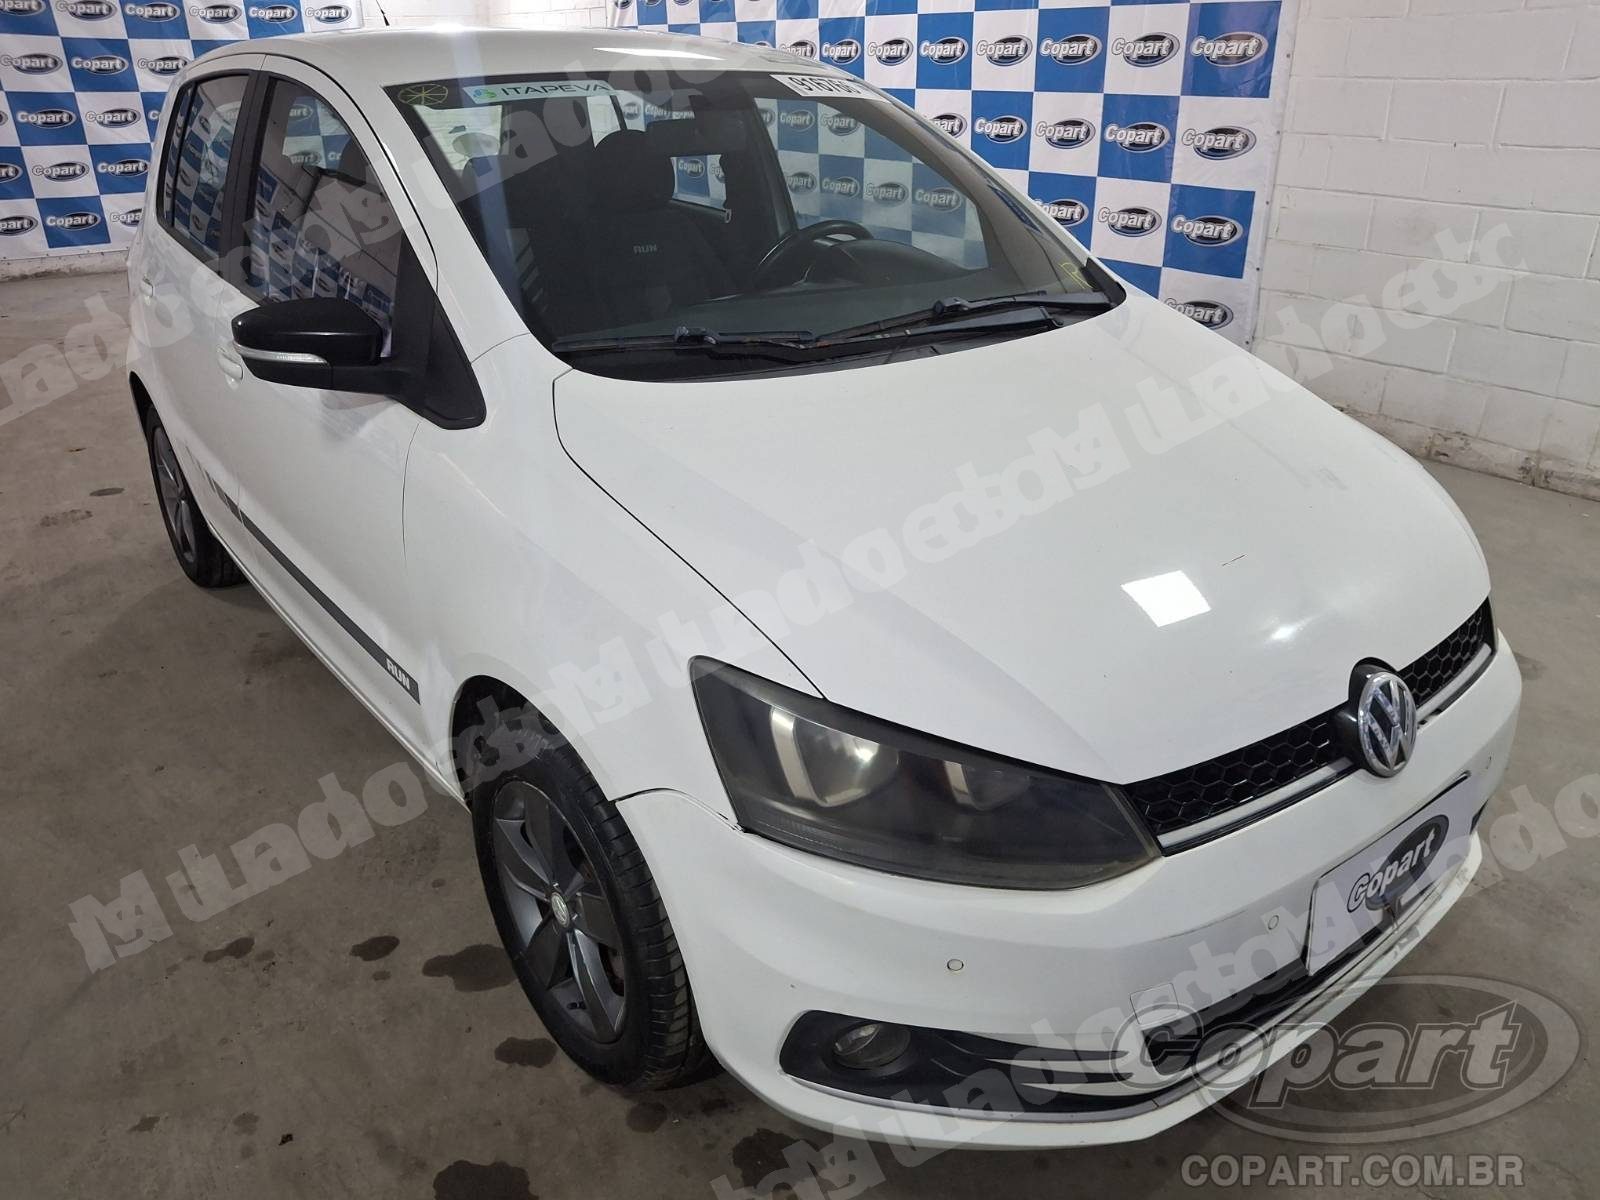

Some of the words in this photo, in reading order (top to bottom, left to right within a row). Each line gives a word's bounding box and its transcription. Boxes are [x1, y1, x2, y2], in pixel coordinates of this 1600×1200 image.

[0, 0, 38, 11] opart
[57, 0, 111, 16] Copart
[125, 4, 175, 17] Copart
[190, 6, 235, 19] Copart
[249, 7, 292, 18] Copart
[306, 7, 346, 19] Copart
[822, 42, 858, 58] Copart
[868, 41, 907, 58] Copart
[920, 40, 963, 58] Copart
[976, 40, 1026, 59] Copart
[1041, 38, 1096, 58] Copart
[1112, 38, 1171, 59] Copart
[1190, 36, 1259, 59] Copart
[1, 55, 54, 70] Copart
[72, 57, 122, 70] Copart
[138, 58, 187, 72] Copart
[501, 84, 611, 96] ITAPEVA
[17, 111, 71, 125] Copart
[86, 111, 134, 125] Copart
[780, 111, 811, 126] Copart
[974, 117, 1021, 138] Copart
[1036, 121, 1090, 141] Copart
[1105, 124, 1162, 146] Copart
[1182, 128, 1245, 150] Copart
[33, 164, 83, 178] Copart
[98, 161, 145, 174] Copart
[823, 178, 856, 194] Copart
[866, 183, 903, 198] Copart
[915, 189, 957, 206] Copart
[47, 215, 95, 228] Copart
[111, 212, 142, 223] Copa
[1098, 207, 1153, 228] Copart
[0, 219, 31, 232] part
[1171, 214, 1237, 239] Copart
[386, 658, 410, 690] RUN
[1347, 827, 1437, 913] Copart
